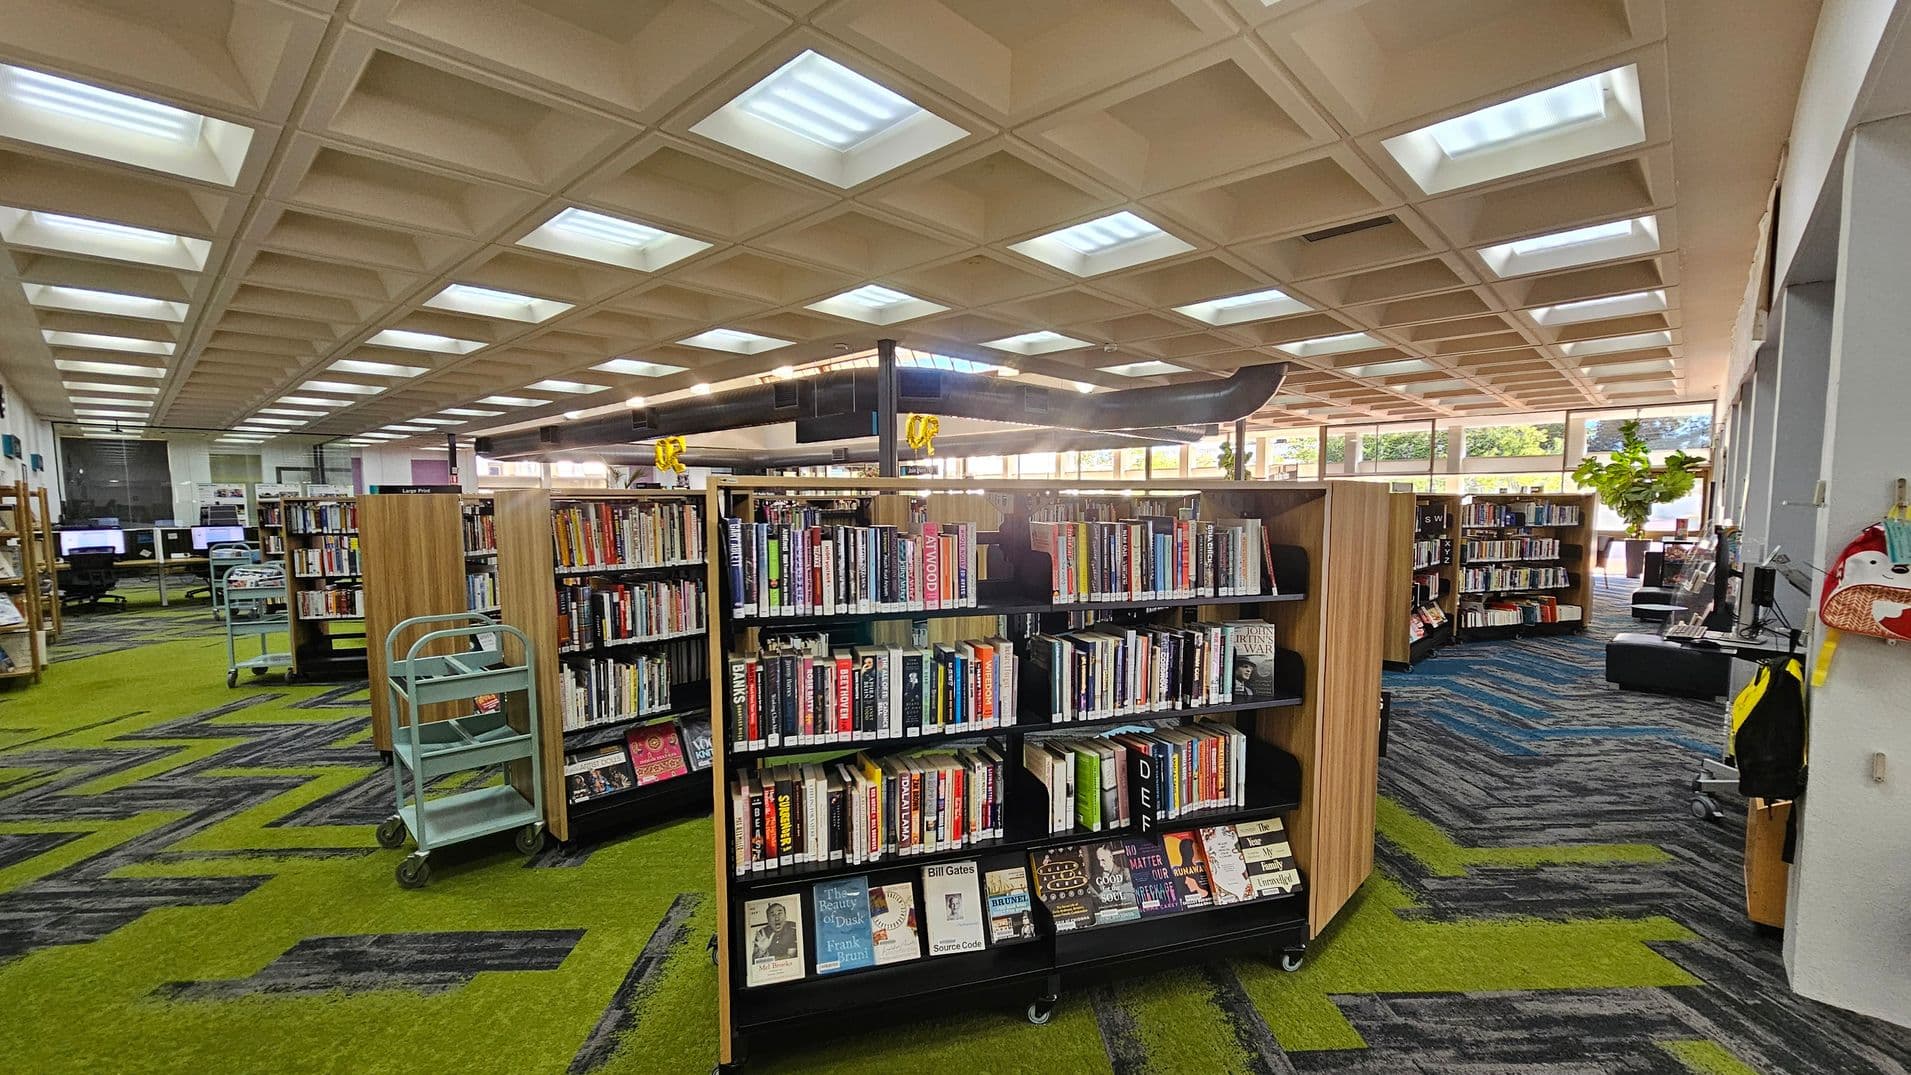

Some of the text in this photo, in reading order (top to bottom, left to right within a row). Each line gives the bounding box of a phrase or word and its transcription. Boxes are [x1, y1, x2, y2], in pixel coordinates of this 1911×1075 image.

[926, 535, 937, 591] ATWOOD
[1244, 643, 1273, 654] WAR
[732, 664, 745, 704] BANKS
[840, 668, 849, 720] BEETHOVEN
[901, 780, 909, 841] DALAI LAMA
[778, 795, 792, 847] SURRENDER
[1257, 823, 1270, 833] The
[1246, 837, 1263, 847] Year
[1125, 844, 1137, 857] NO
[1262, 847, 1273, 858] My
[1129, 854, 1164, 870] MATTER
[1260, 859, 1284, 872] Family
[928, 865, 976, 878] Bill Gates
[1151, 867, 1170, 880] OUR
[1095, 874, 1123, 886] GOOD
[1257, 873, 1293, 888] Unravelled
[823, 888, 848, 900] The
[1100, 892, 1126, 903] SOUL
[818, 898, 858, 912] Beauty
[991, 895, 1029, 908] BRUNEL
[823, 911, 865, 928] of Dusk
[826, 935, 861, 952] Frank
[933, 941, 982, 953] Source Code
[836, 949, 869, 963] Bruni
